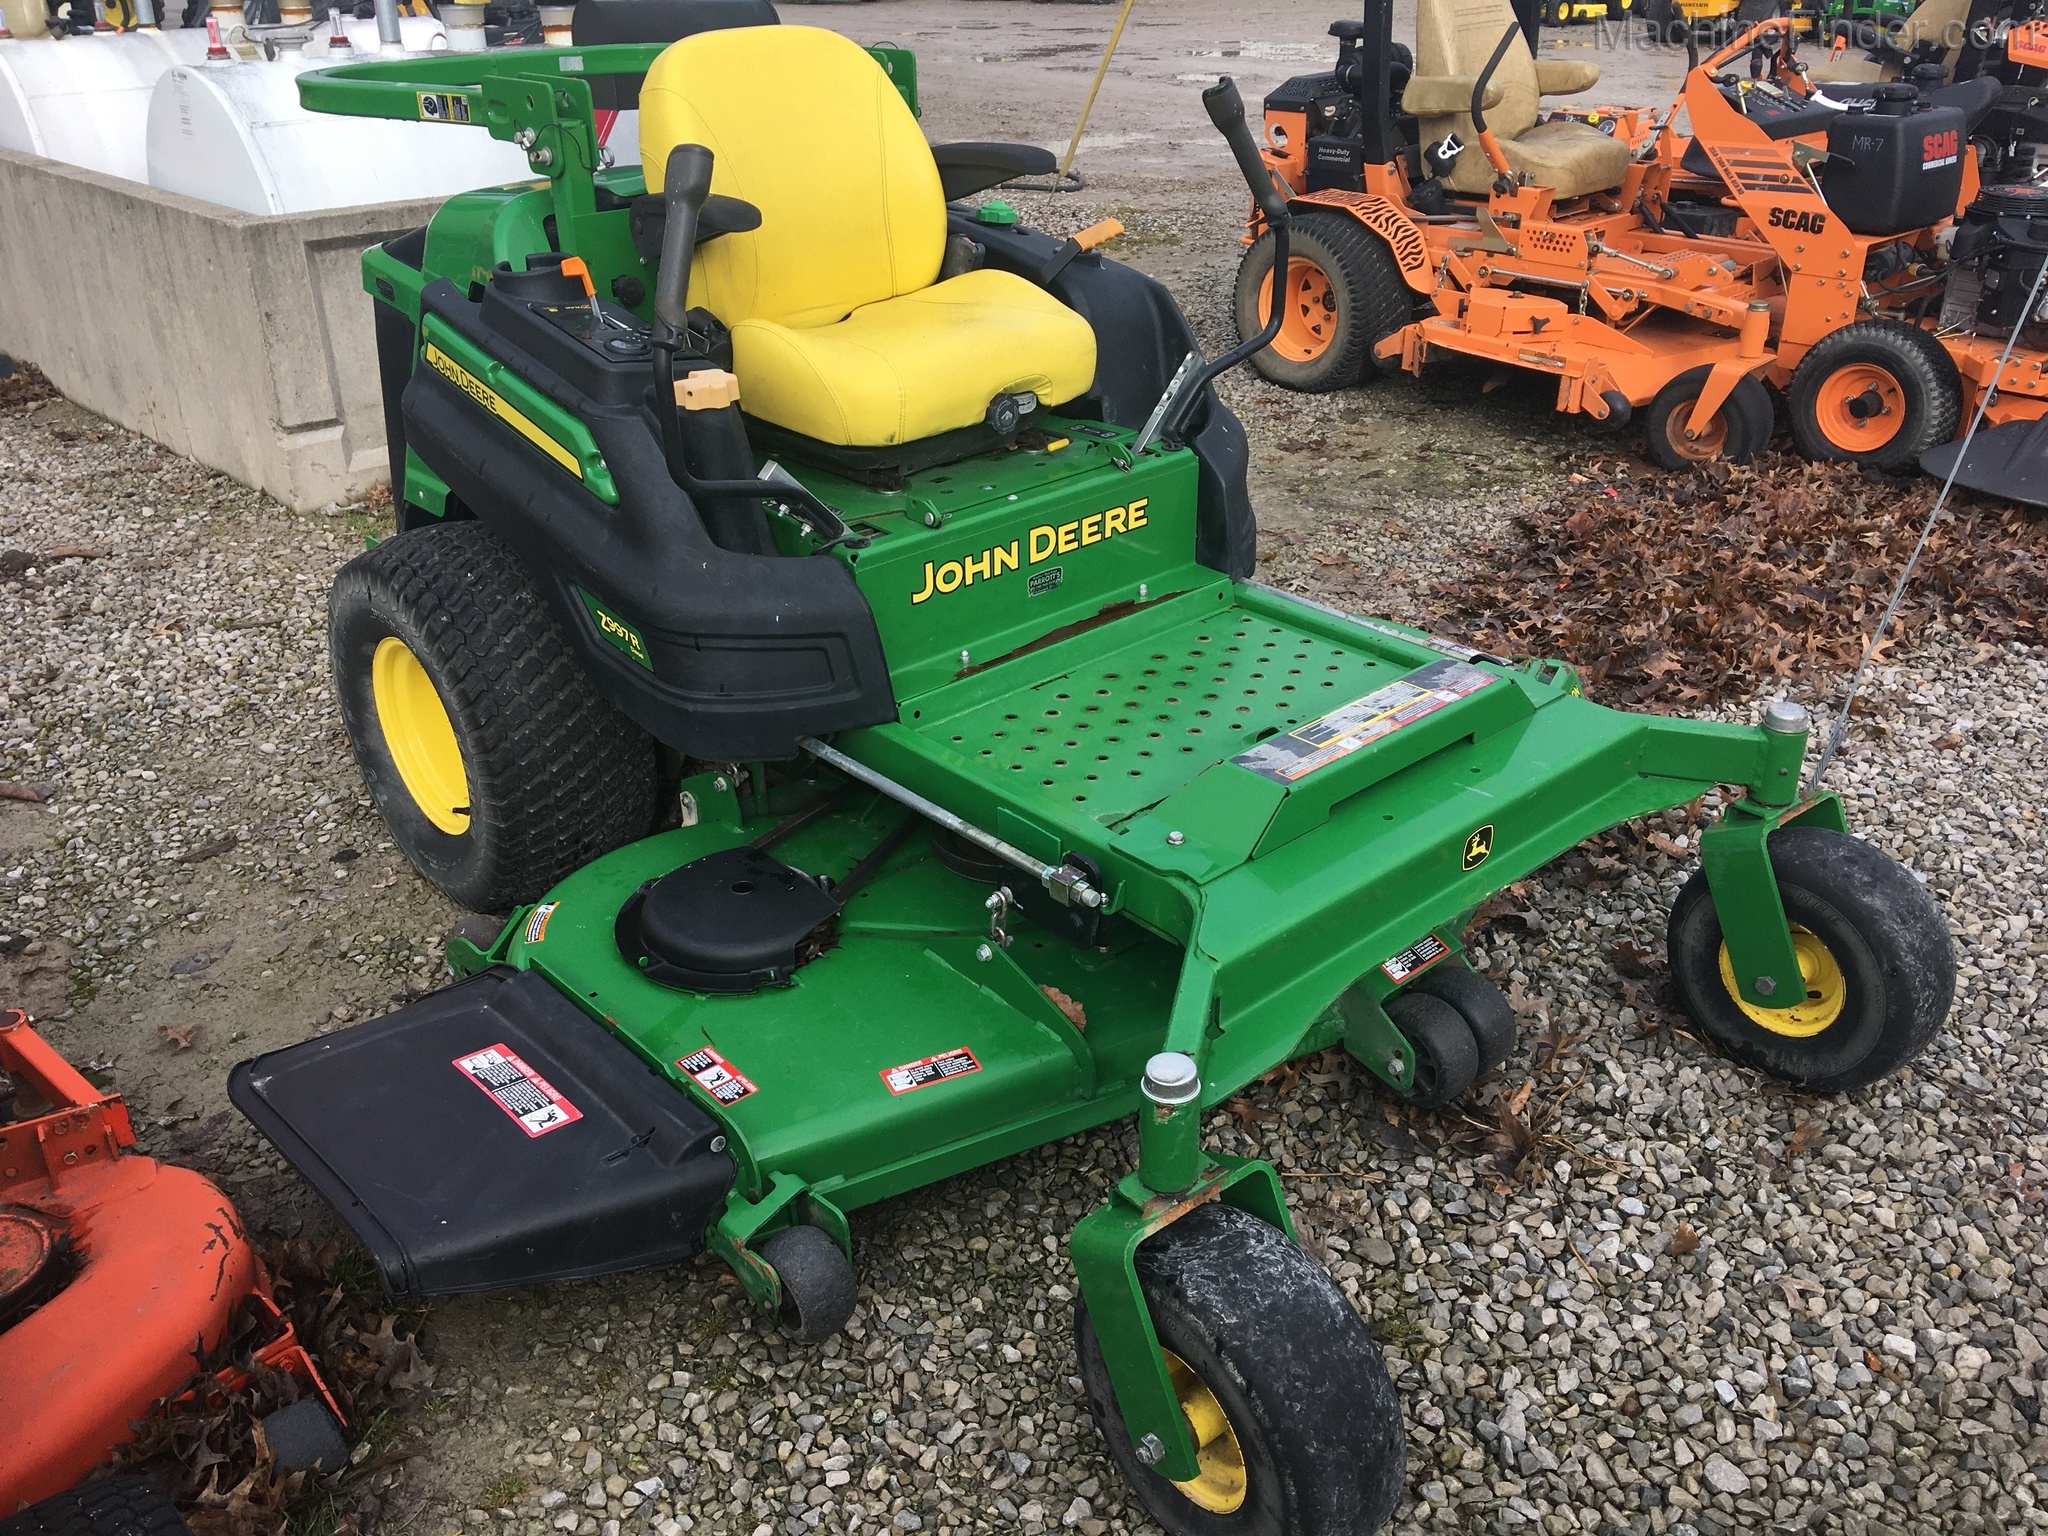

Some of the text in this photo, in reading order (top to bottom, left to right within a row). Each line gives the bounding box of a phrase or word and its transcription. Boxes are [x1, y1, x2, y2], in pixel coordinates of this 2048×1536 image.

[1318, 146, 1350, 156] Heavy-Duty
[1853, 135, 1884, 151] MR-7
[1923, 129, 1958, 161] SCAG
[1317, 154, 1351, 163] Commercial
[1769, 206, 1826, 235] SCAG
[432, 350, 498, 414] JOHN DEERE
[911, 496, 1149, 605] JOHN DEERE
